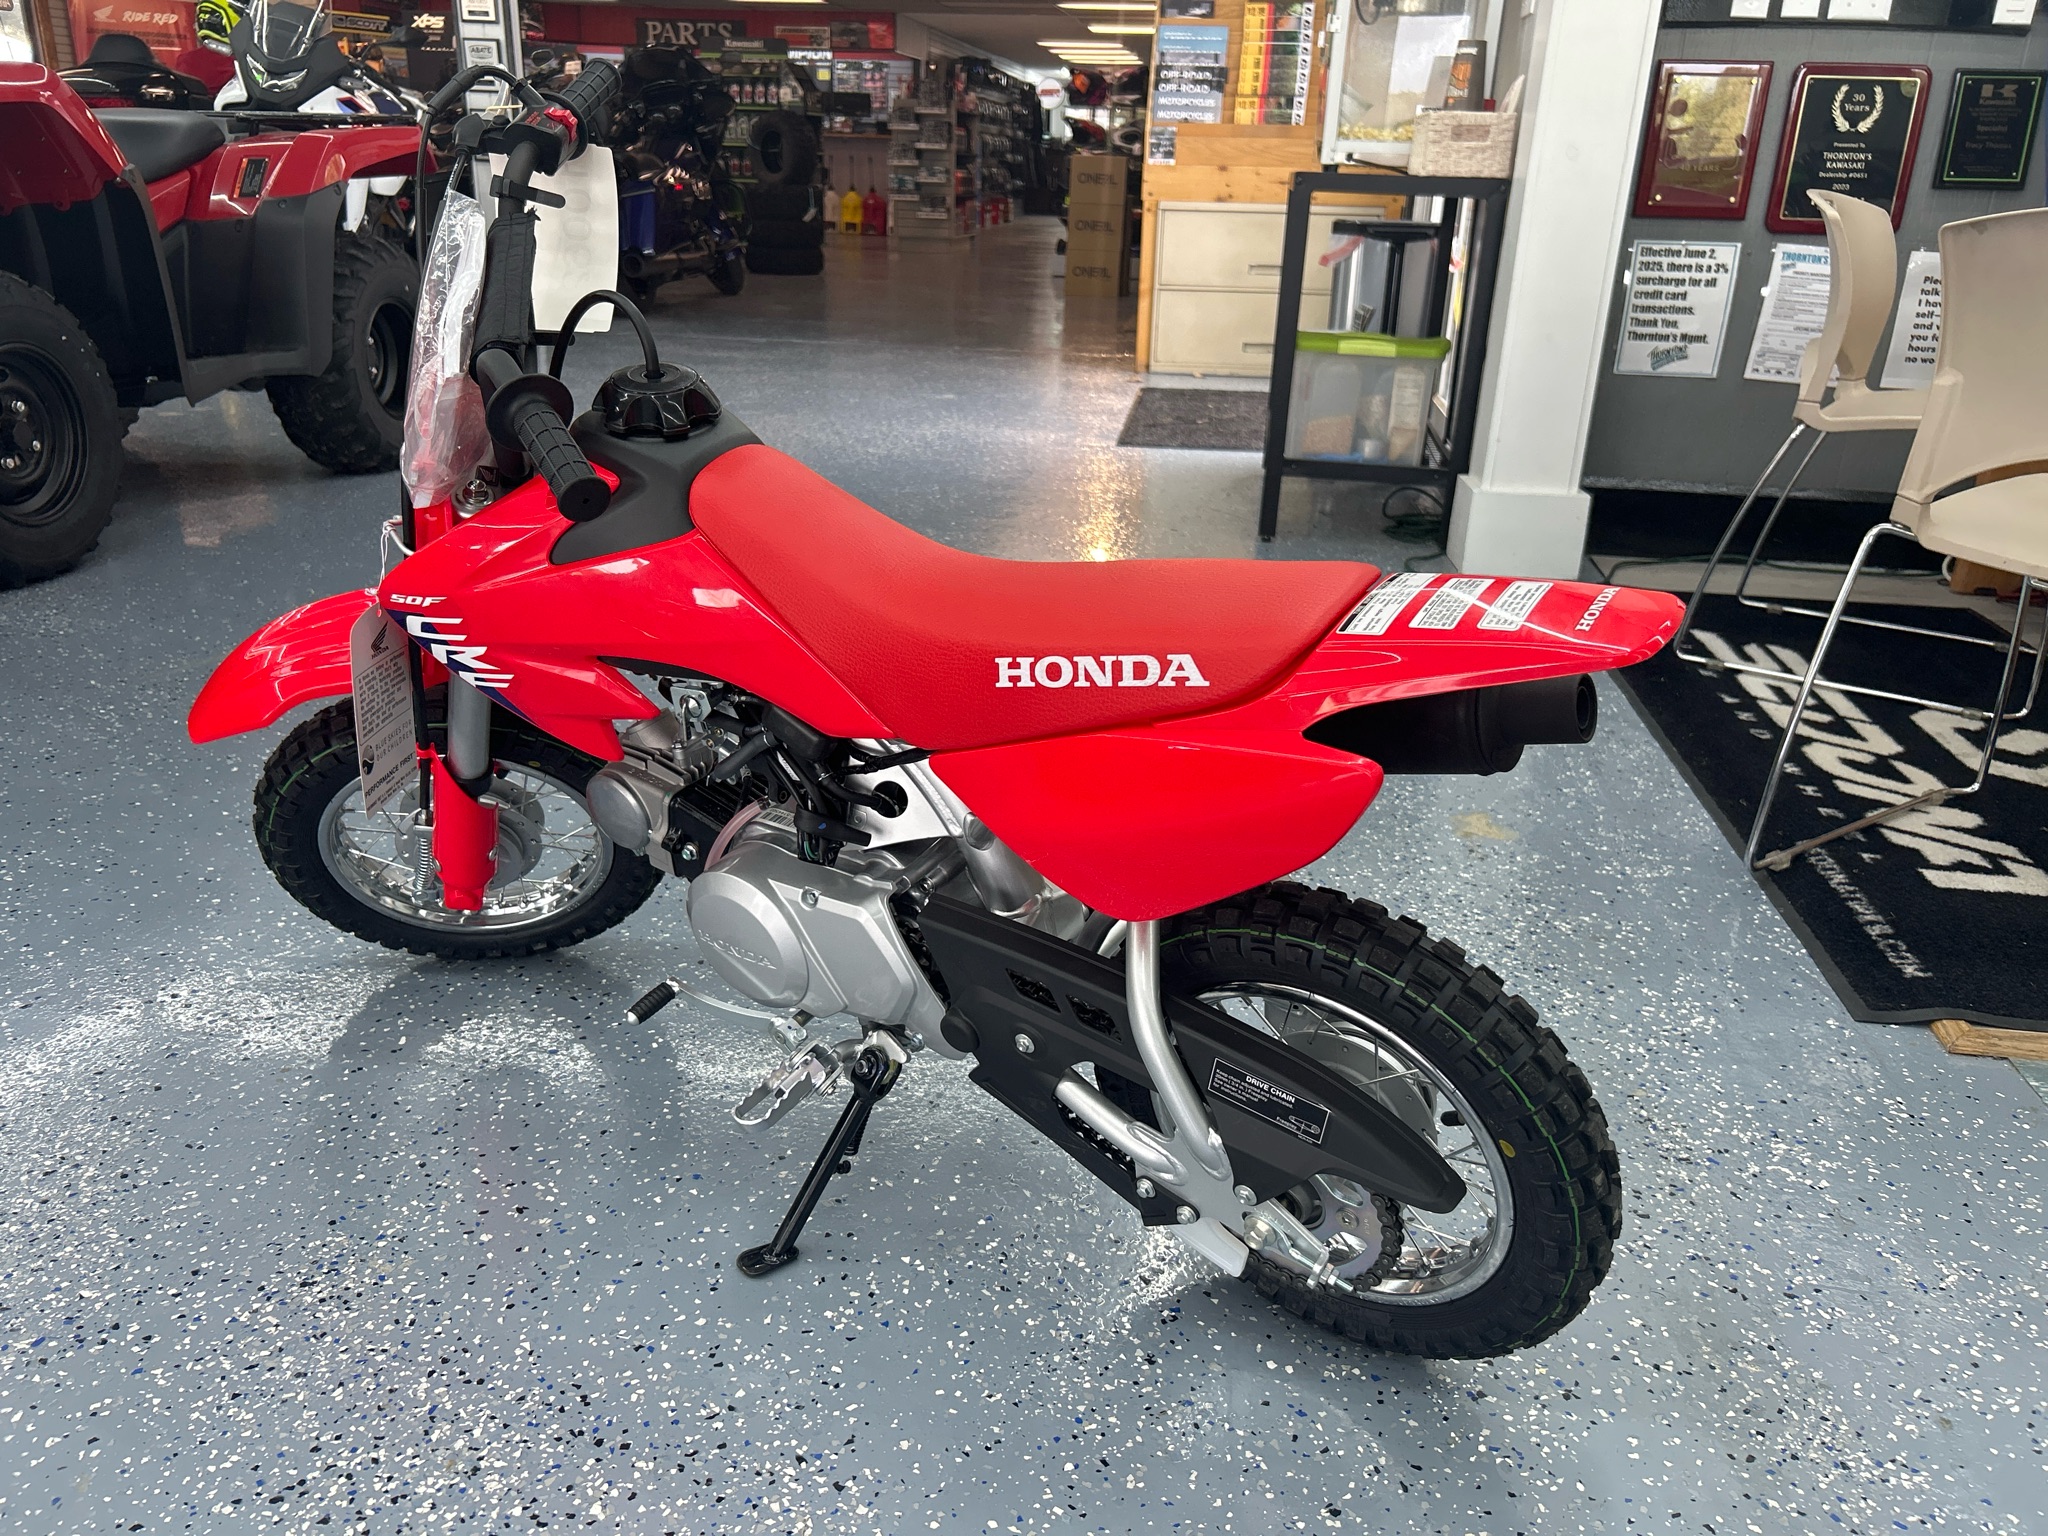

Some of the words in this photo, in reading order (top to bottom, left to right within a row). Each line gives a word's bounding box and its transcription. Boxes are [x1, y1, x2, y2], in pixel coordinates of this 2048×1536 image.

[122, 10, 151, 22] RIDE
[153, 12, 179, 25] RED
[411, 13, 446, 28] XPS
[347, 18, 388, 31] SCOTT
[645, 21, 733, 45] PARTS
[1160, 70, 1213, 80] OFF-ROAD
[1158, 83, 1210, 94] OFF-ROAD
[1852, 93, 1866, 102] 30
[1844, 103, 1870, 112] Years
[1823, 152, 1872, 161] THORNTON'S
[1825, 161, 1865, 169] KAWASAKI
[1640, 247, 1682, 258] Effective
[1683, 248, 1707, 259] June
[1781, 251, 1829, 265] THORNTON'S
[1666, 262, 1692, 272] there
[1695, 263, 1704, 273] is
[1706, 265, 1713, 273] a
[1714, 263, 1729, 274] 3%
[1636, 276, 1686, 288] surcharge
[1688, 276, 1702, 287] for
[1704, 277, 1717, 288] all
[1634, 289, 1663, 300] credit
[1665, 290, 1687, 301] card
[1920, 288, 1940, 296] talk
[1630, 317, 1658, 328] Thank
[1913, 322, 1933, 330] and
[1627, 331, 1678, 343] Thornton's
[1679, 333, 1709, 345] Mgmt.
[1910, 334, 1928, 342] you
[1908, 344, 1936, 353] hours
[1904, 355, 1917, 363] no
[390, 594, 447, 607] 50F
[1575, 587, 1621, 631] HONDA
[371, 645, 389, 659] HONDA
[406, 615, 514, 688] CRF
[995, 654, 1210, 688] HONDA
[375, 736, 386, 751] BLUE
[387, 724, 401, 741] SKIES
[402, 717, 411, 730] FOR
[376, 748, 386, 762] OUR
[387, 727, 412, 753] CHILDREN
[364, 763, 399, 798] PERFORMANCE
[399, 751, 412, 768] FIRST
[699, 930, 776, 969] HONDA
[1215, 1069, 1227, 1078] Keep
[1228, 1074, 1240, 1083] chain
[1240, 1080, 1260, 1093] adjusted
[1245, 1075, 1269, 1091] DRIVE
[1270, 1086, 1295, 1103] CHAIN
[1241, 1091, 1258, 1102] manual
[1276, 1116, 1297, 1130] Freeplay
